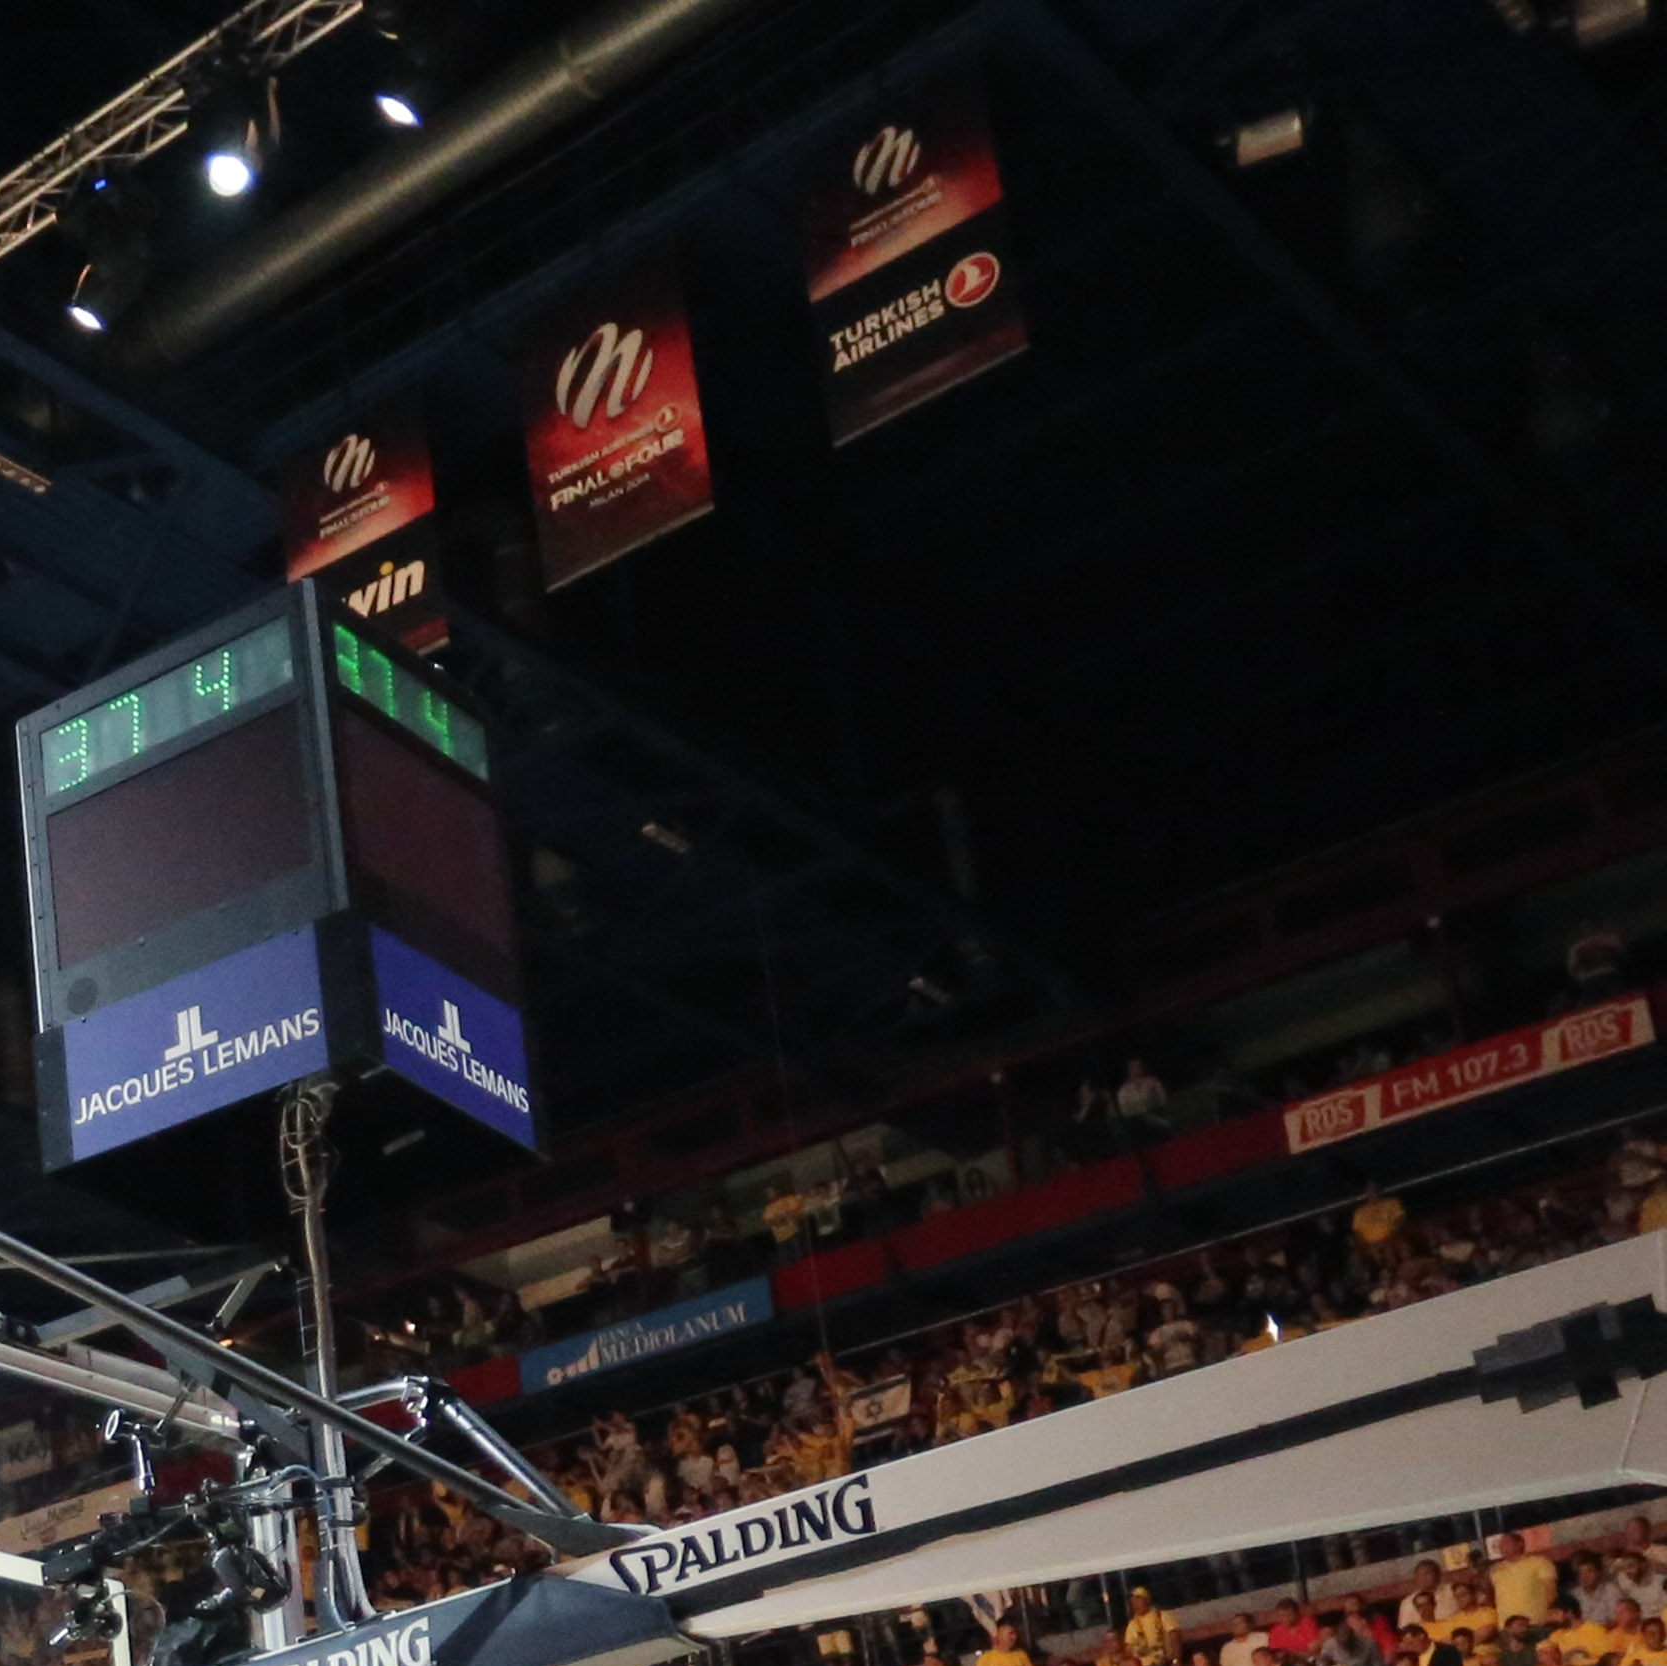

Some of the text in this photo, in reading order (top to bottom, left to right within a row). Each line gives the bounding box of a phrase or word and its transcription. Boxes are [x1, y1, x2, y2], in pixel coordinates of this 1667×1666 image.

[829, 278, 941, 350] TURKISH
[833, 299, 945, 373] AIRLINES
[550, 428, 685, 512] FINAL FOUR
[75, 1008, 320, 1125] JACQUES LEMANS
[383, 1007, 530, 1115] JACQUES LEMANS
[1305, 1013, 1621, 1137] RDS FM 107.3 RDS
[598, 1303, 746, 1364] MEDIOLANUM
[609, 1474, 876, 1595] SPALDING
